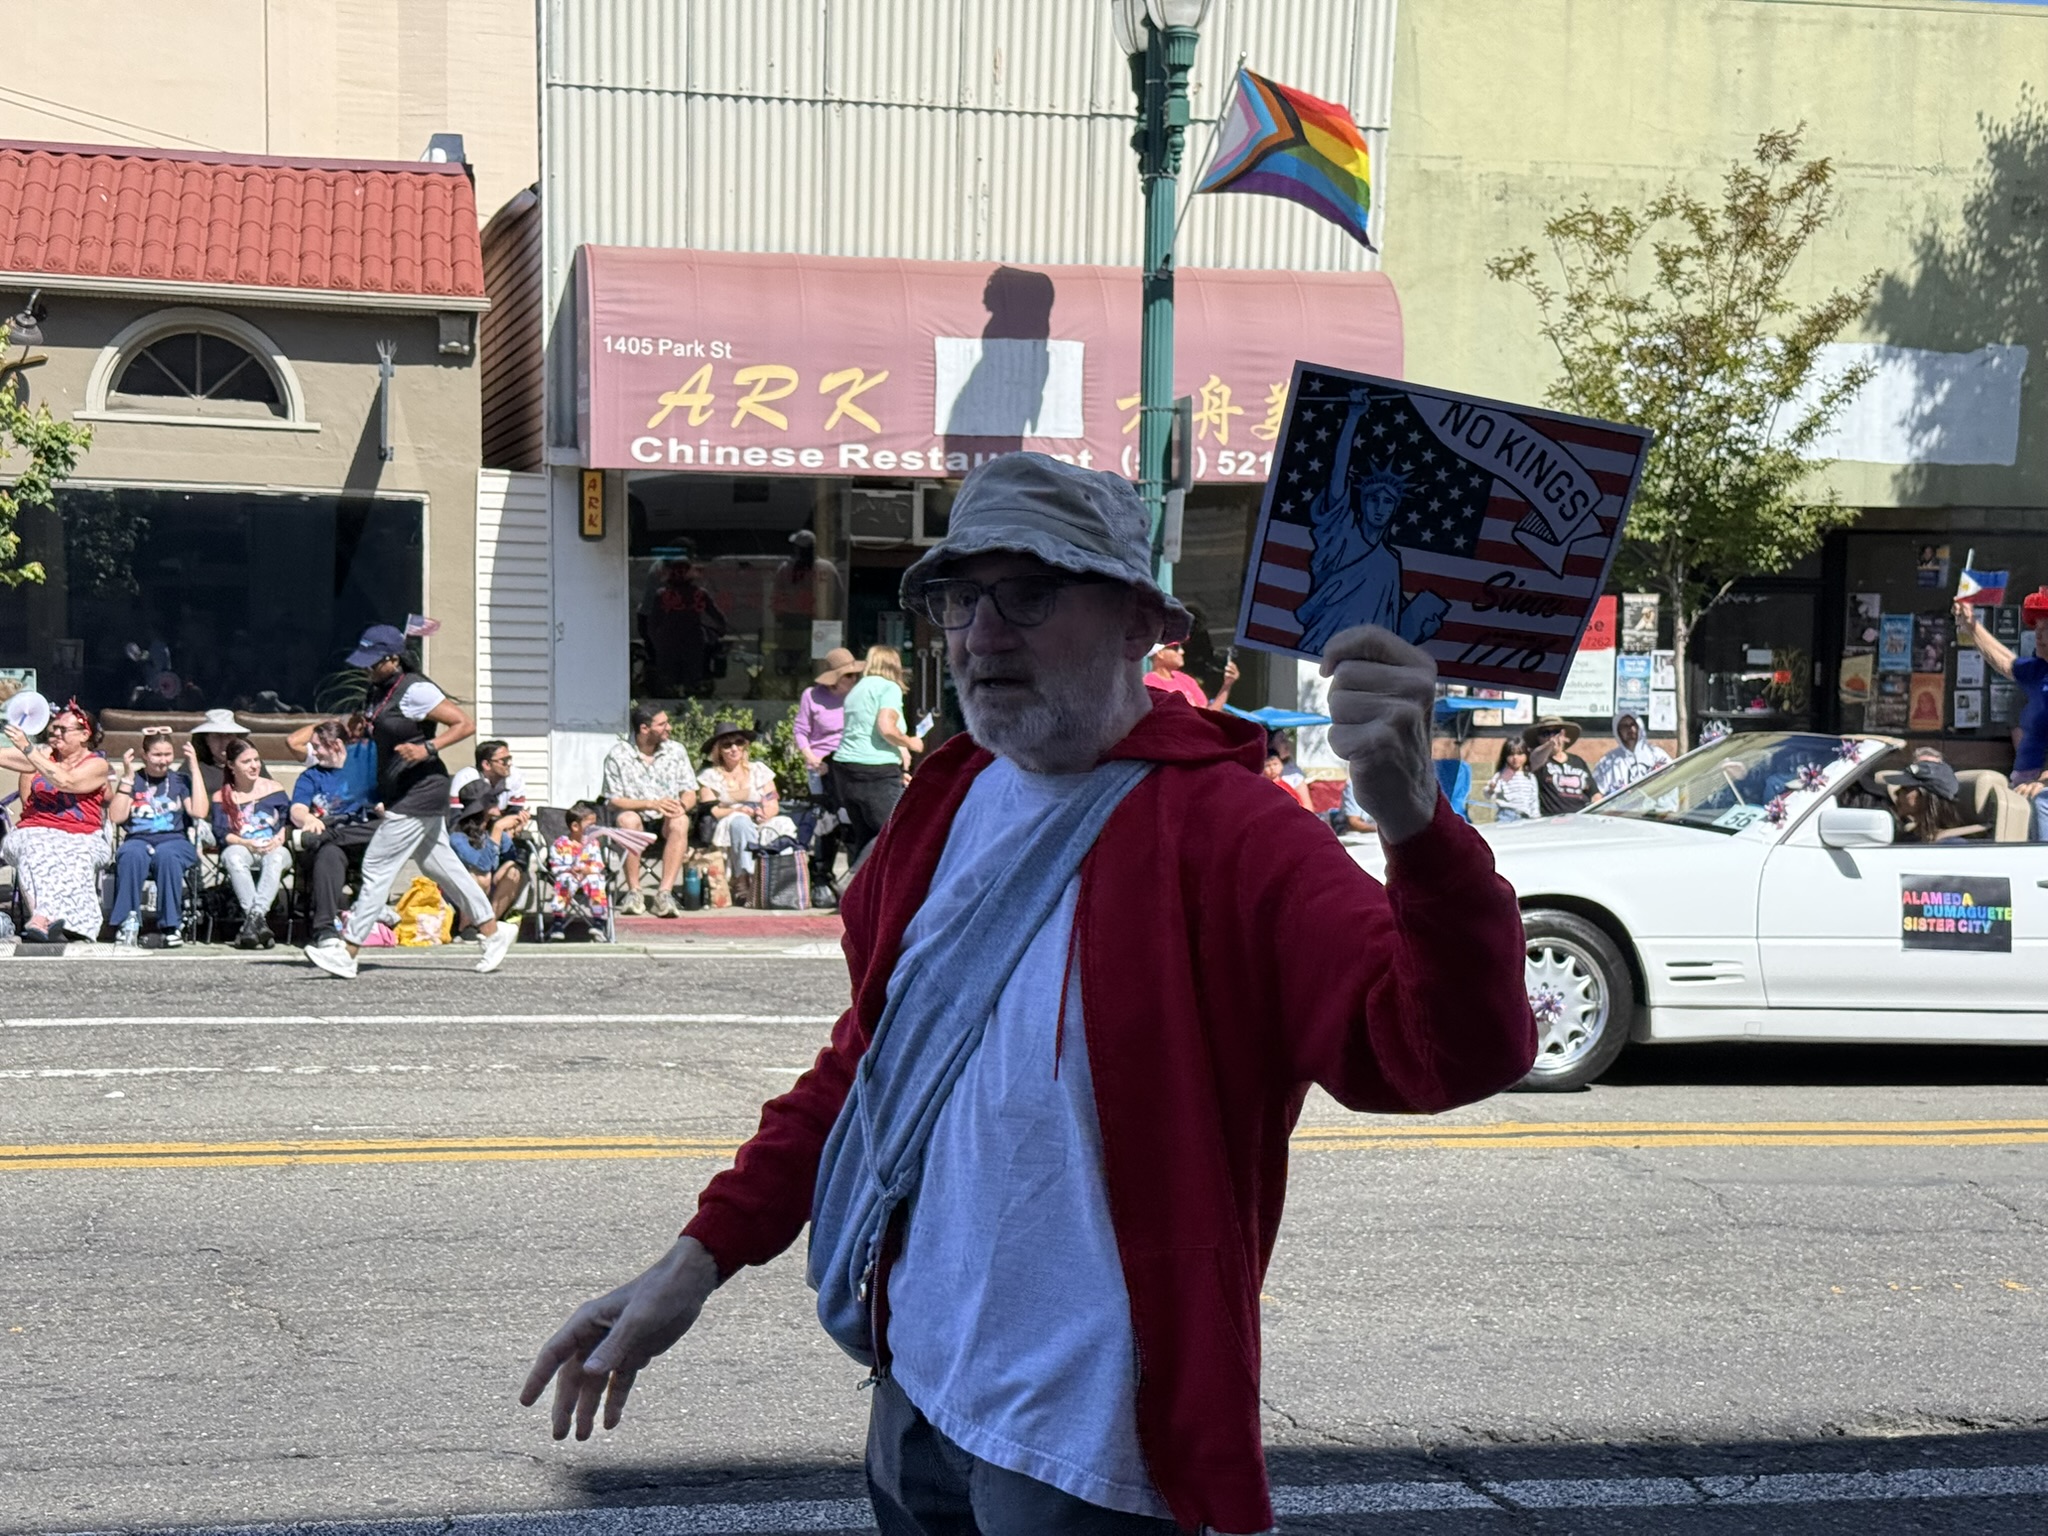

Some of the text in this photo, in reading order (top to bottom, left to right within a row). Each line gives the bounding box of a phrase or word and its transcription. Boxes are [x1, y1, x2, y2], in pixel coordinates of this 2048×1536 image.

[602, 335, 732, 361] 1405 Park St
[646, 362, 890, 435] ARK
[630, 436, 826, 469] Chinese
[1438, 401, 1589, 522] NO KINGS
[587, 478, 600, 528] ARK
[1472, 570, 1566, 618] Since
[1458, 630, 1560, 673] 1776
[1724, 812, 1757, 828] 56
[1902, 890, 1974, 907] ALAMEDA
[1923, 904, 2012, 921] DUMAGUETE
[1903, 916, 1993, 934] SISTER CITY
